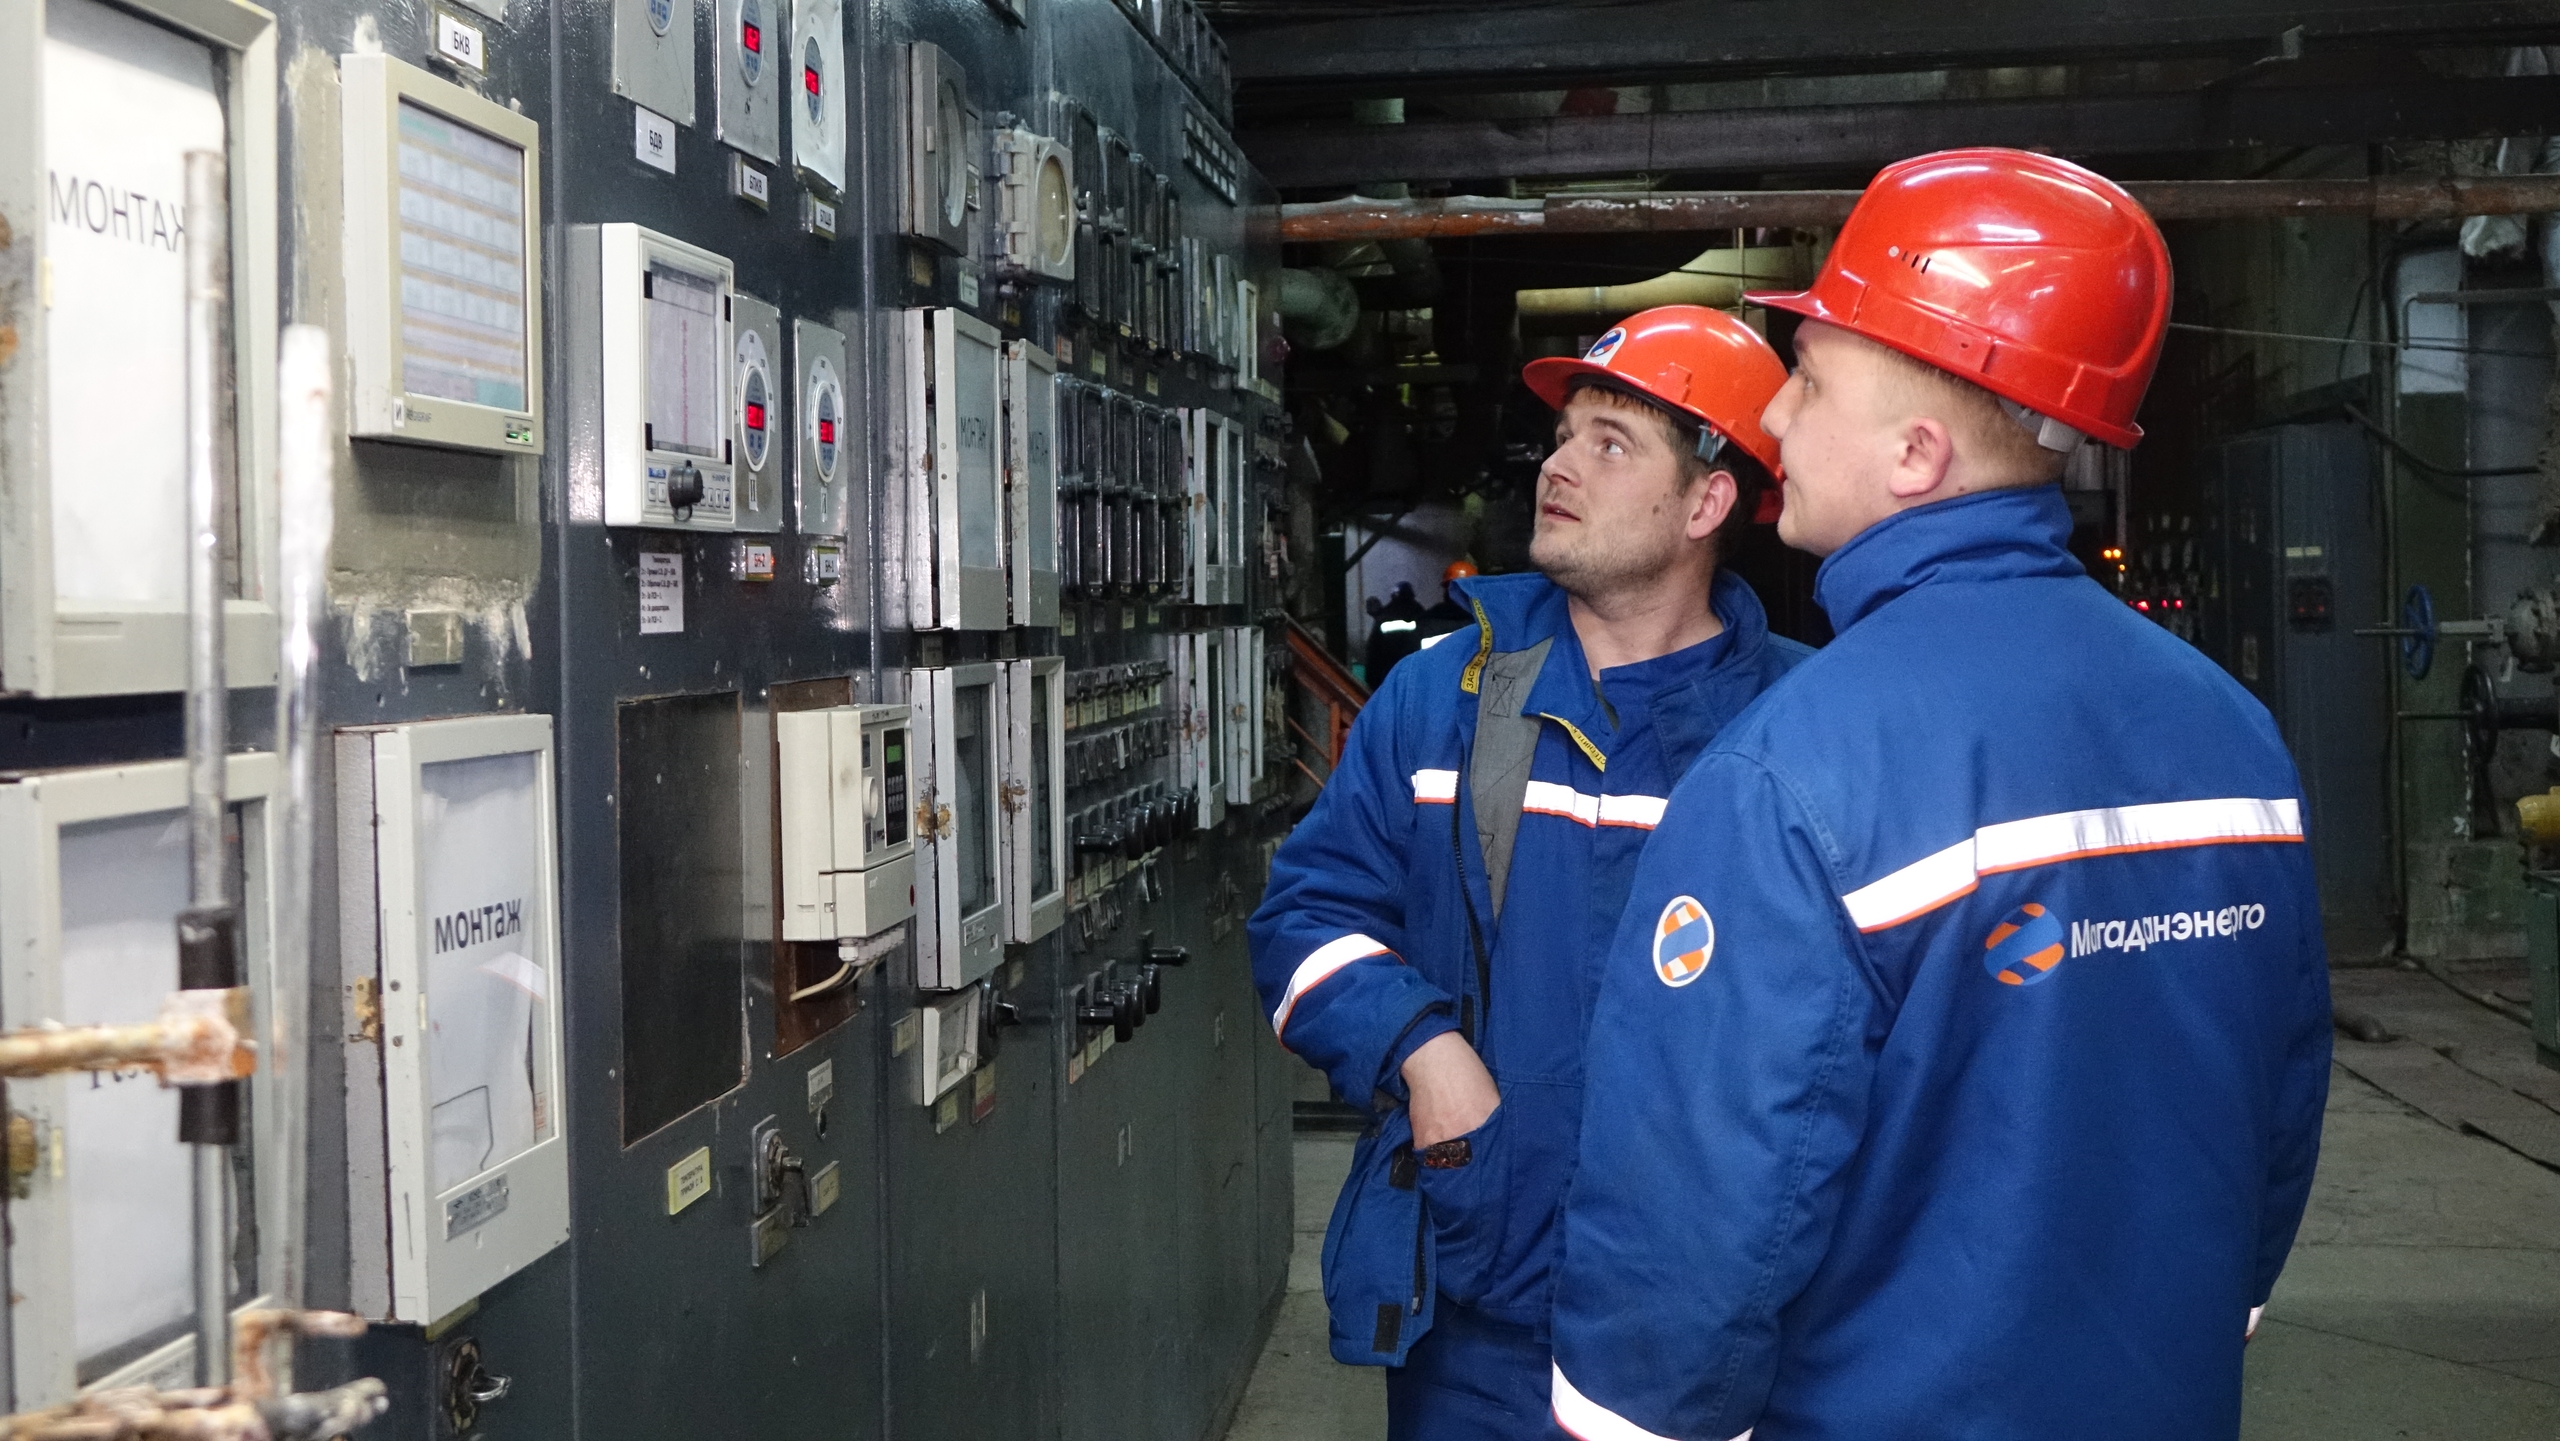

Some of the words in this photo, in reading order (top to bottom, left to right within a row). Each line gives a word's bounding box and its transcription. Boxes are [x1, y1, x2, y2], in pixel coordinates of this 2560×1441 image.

[453, 31, 470, 55] БКВ
[649, 129, 663, 152] БДВ
[1467, 637, 1491, 689] ЗАСТЕГНИТЕ
[2070, 902, 2266, 958] Магаданэнерго
